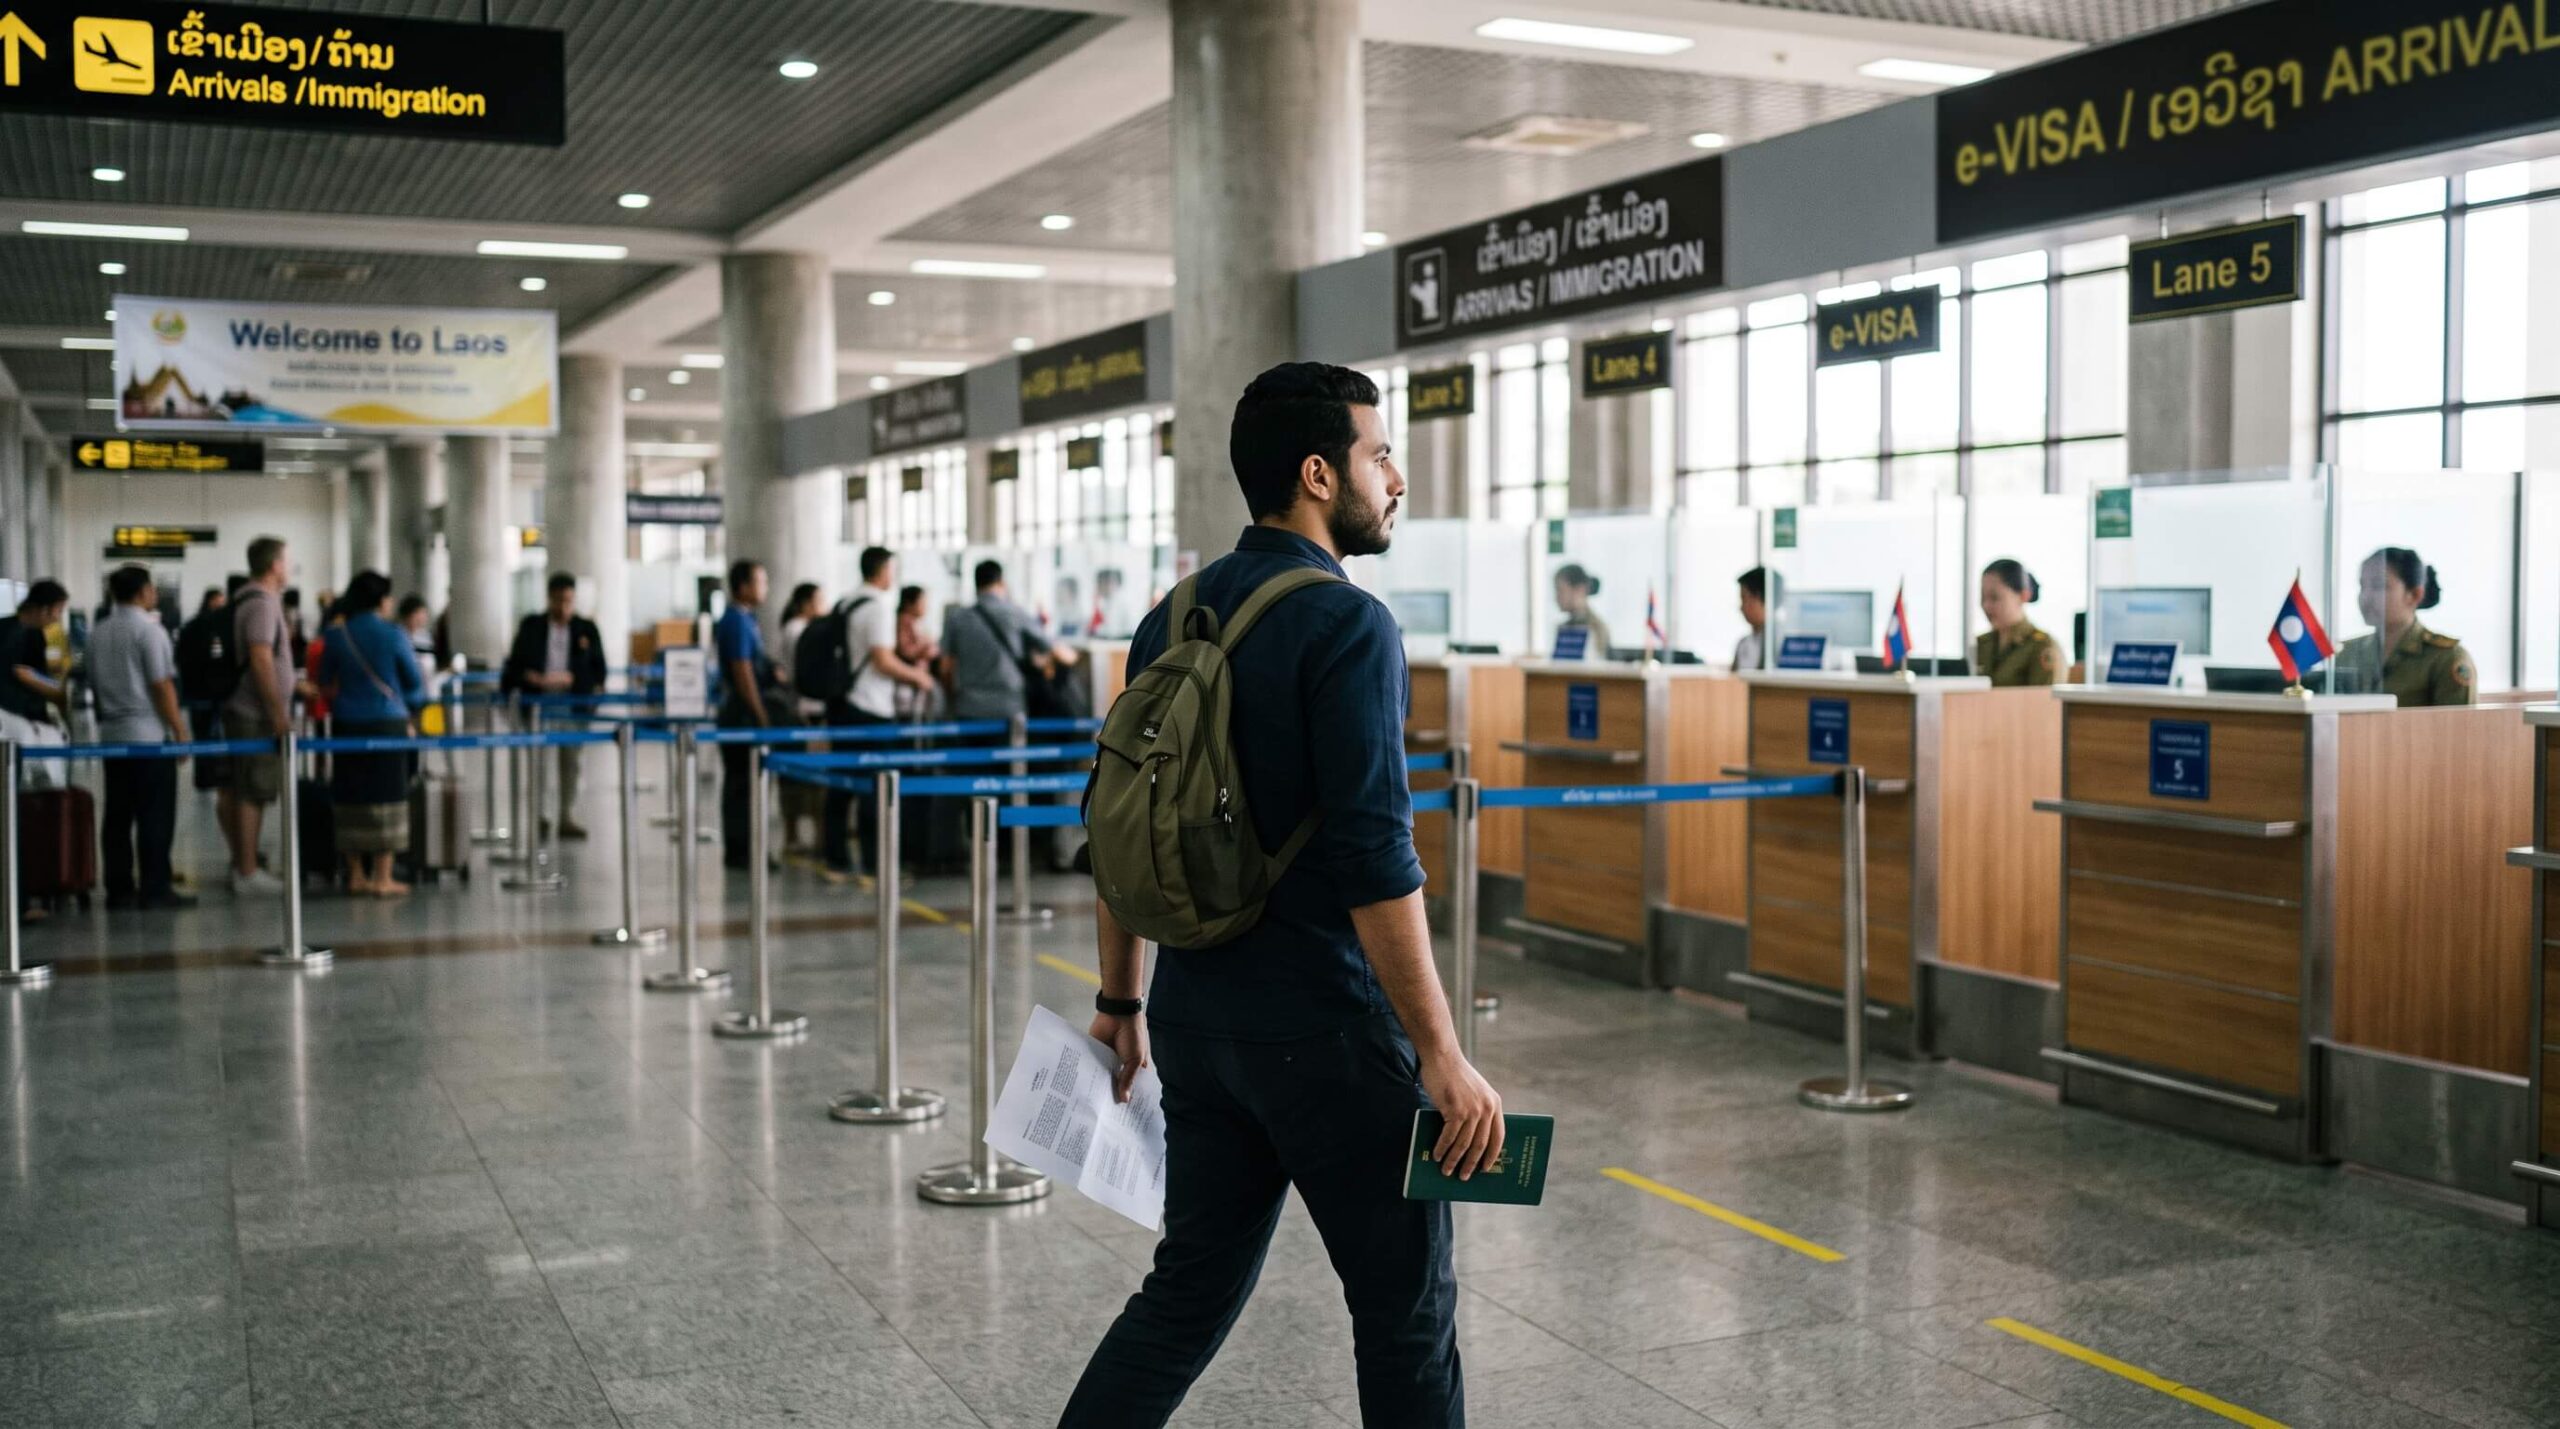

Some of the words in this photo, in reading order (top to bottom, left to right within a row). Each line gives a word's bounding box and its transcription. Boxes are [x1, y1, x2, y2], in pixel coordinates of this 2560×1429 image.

[168, 68, 287, 104] Arrivals
[1956, 101, 2106, 186] e-VISA
[1550, 239, 1705, 305] IMMIGRATION
[2152, 257, 2238, 298] Lane
[2249, 242, 2272, 284] 5
[230, 320, 381, 352] Welcome
[390, 325, 422, 352] to
[433, 327, 508, 354] Laos
[1829, 304, 1919, 351] e-VISA
[1591, 353, 1641, 384] Lane
[1643, 344, 1659, 376] 4
